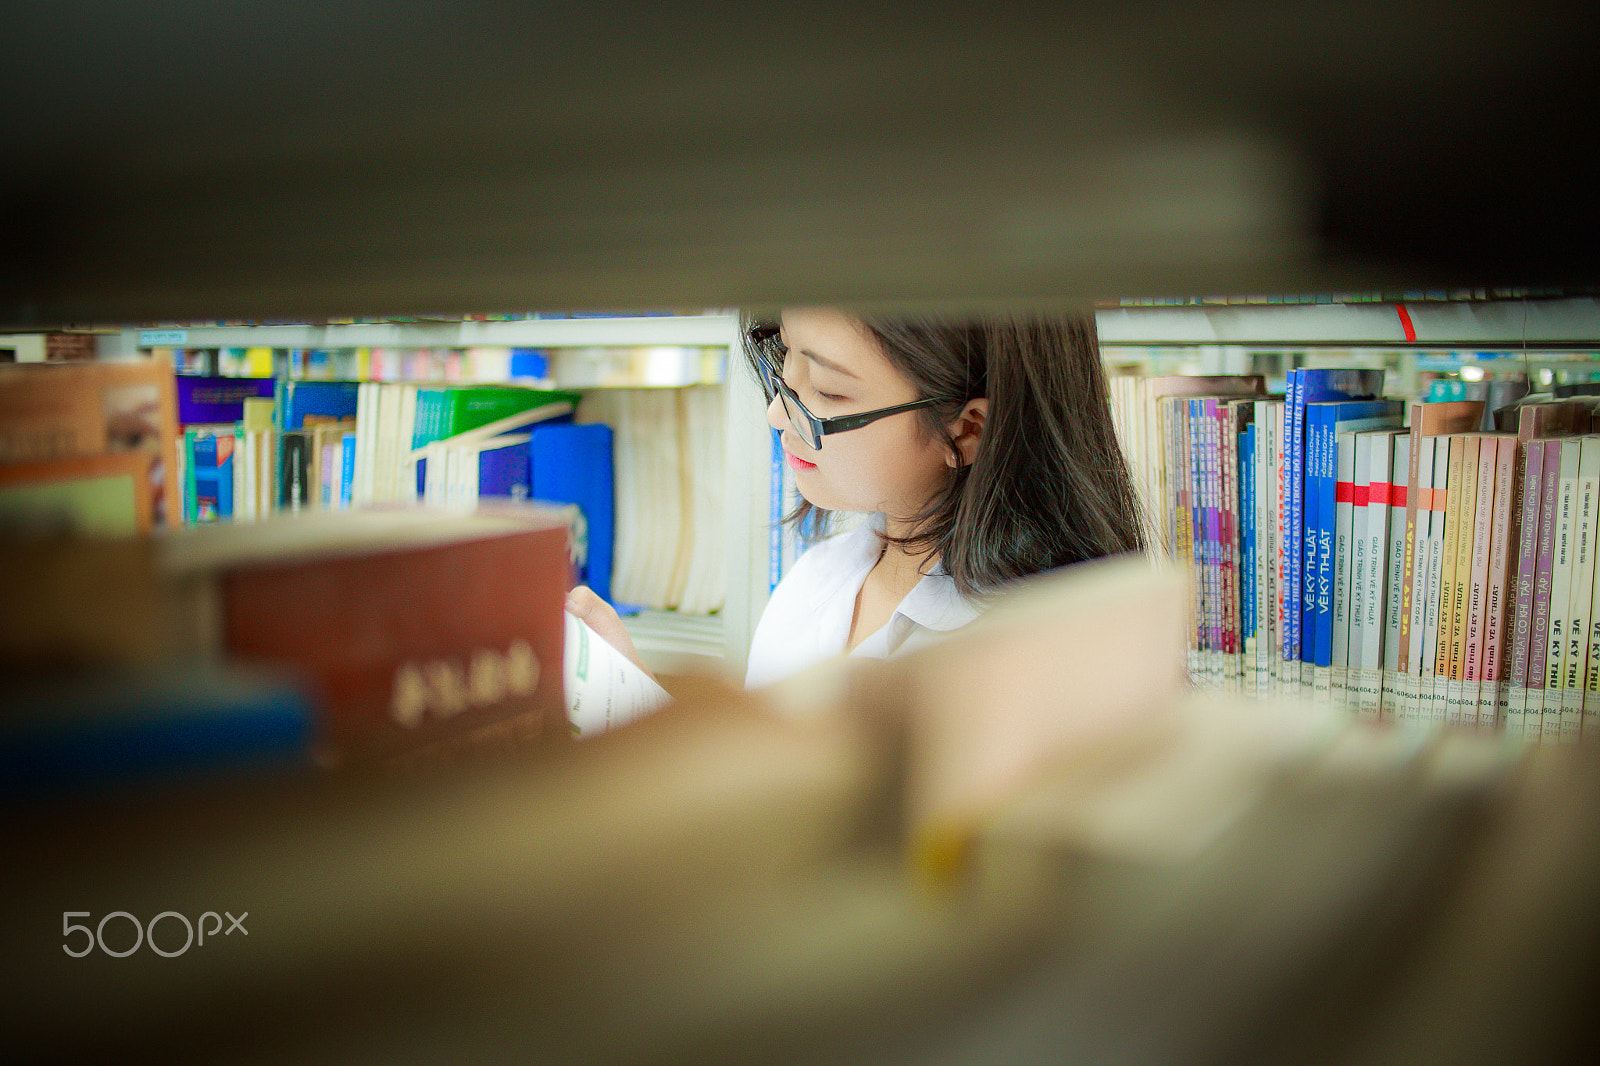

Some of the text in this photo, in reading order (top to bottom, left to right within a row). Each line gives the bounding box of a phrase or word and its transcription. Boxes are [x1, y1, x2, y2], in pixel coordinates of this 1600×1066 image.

[1305, 527, 1317, 612] VẼ KỸ THUẬT
[1318, 529, 1332, 614] VẼ KỸ THUẬT
[1370, 557, 1378, 577] TRÌNH
[1394, 560, 1402, 580] TRÌNH
[1370, 580, 1378, 588] VẼ
[1394, 583, 1401, 591] VẼ
[1369, 591, 1377, 600] KỸ
[1393, 594, 1401, 603] KỸ
[1367, 603, 1375, 625] THUẬT
[1391, 606, 1400, 629] THUẬT
